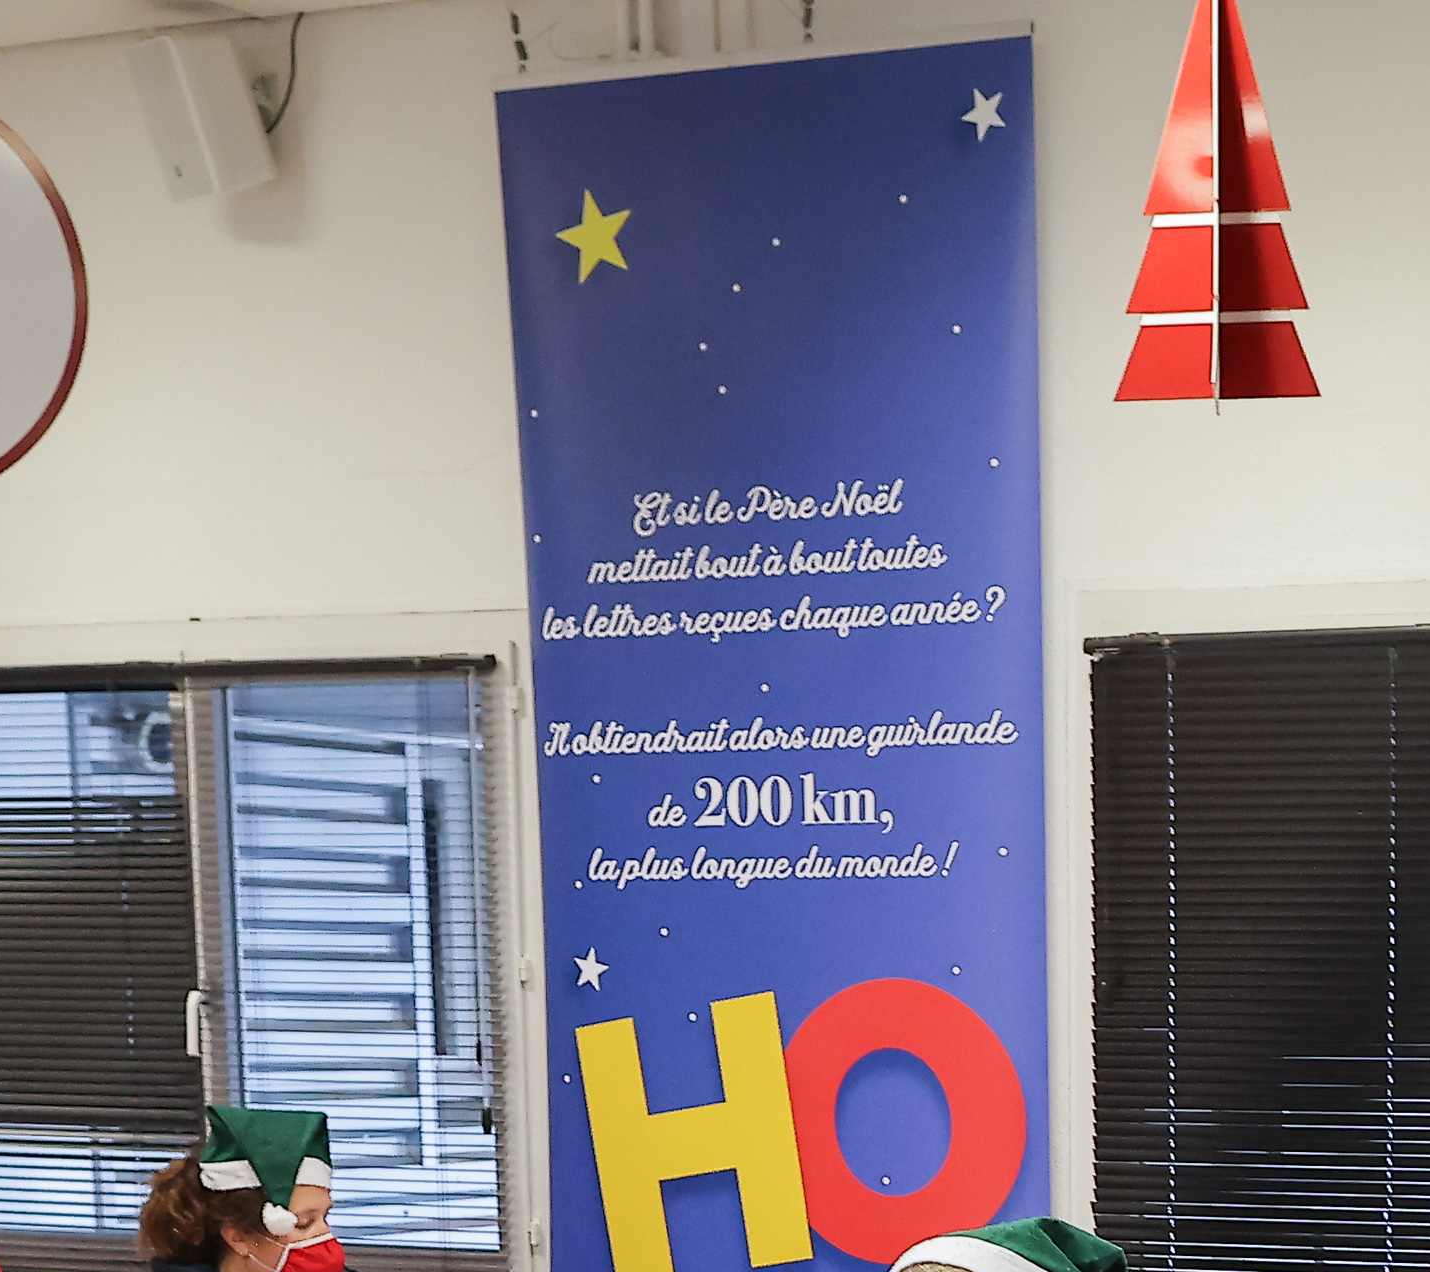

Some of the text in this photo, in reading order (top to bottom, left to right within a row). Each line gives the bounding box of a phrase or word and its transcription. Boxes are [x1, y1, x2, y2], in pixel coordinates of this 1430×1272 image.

[633, 479, 905, 537] Et si le Père Noël
[586, 534, 949, 585] mettait bout à bout toutes
[541, 606, 579, 641] les
[582, 603, 679, 638] lettres
[679, 606, 776, 642] reçues
[778, 595, 890, 637] chaque
[891, 592, 982, 625] année
[573, 720, 729, 755] obtiendrait
[728, 717, 810, 748] alors
[810, 730, 866, 747] une
[865, 710, 1018, 757] guirlande
[649, 772, 895, 834] de 200 km,
[588, 847, 618, 881] la
[614, 851, 688, 890] plus
[690, 846, 793, 888] longue
[794, 849, 835, 880] du
[834, 843, 939, 879] monde
